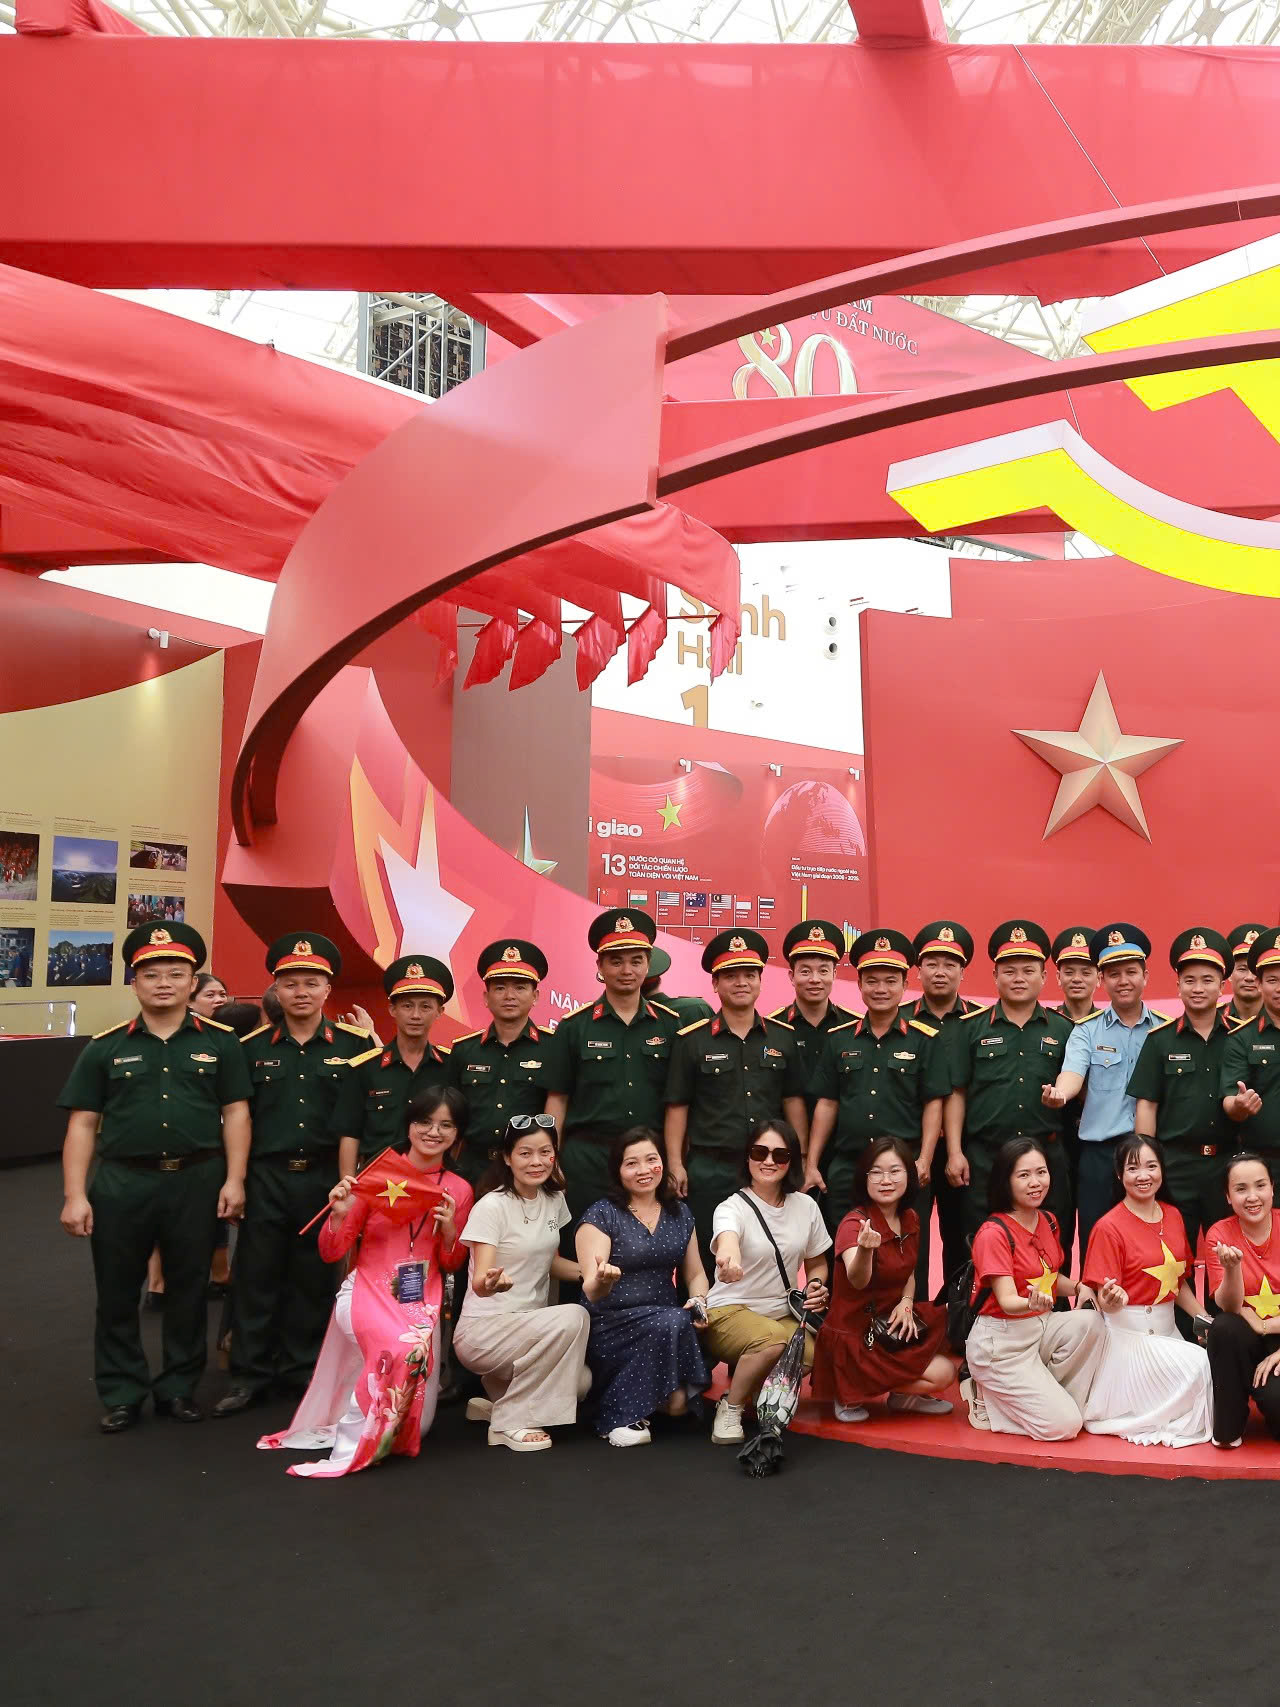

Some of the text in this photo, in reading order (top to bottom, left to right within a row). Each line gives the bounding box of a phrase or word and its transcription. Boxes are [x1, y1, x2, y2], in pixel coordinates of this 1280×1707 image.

[836, 311, 869, 336] ĐẤT
[872, 325, 919, 355] NƯỚC
[679, 588, 786, 641] Snh
[596, 818, 643, 838] giao
[601, 853, 627, 876] 13
[551, 989, 585, 1014] NÂN
